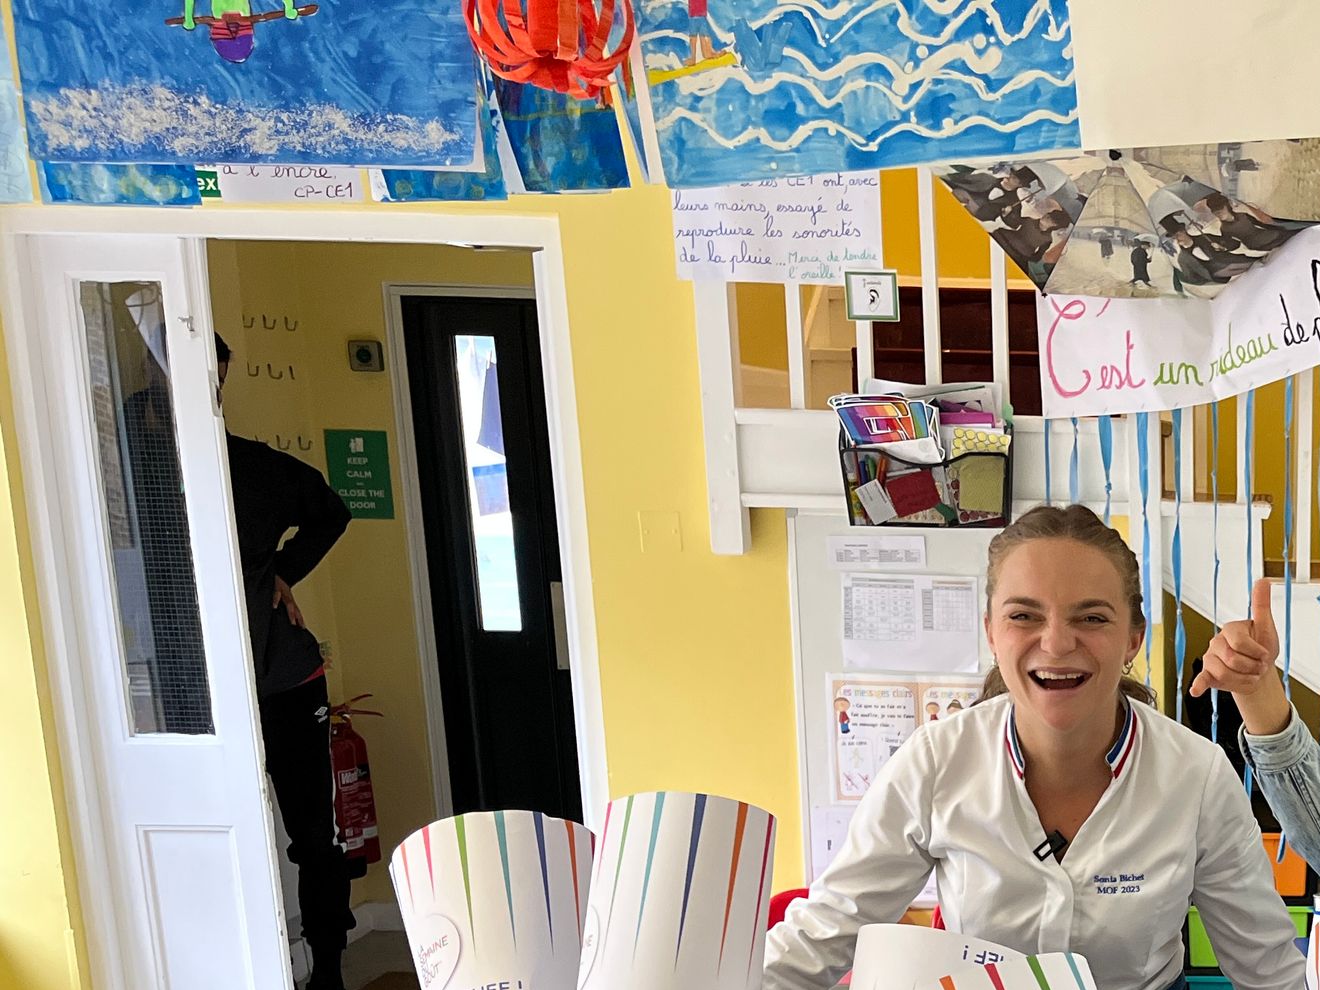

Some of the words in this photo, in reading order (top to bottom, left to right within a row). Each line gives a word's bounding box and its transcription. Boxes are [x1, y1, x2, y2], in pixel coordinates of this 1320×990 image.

[196, 177, 217, 191] ex
[294, 182, 353, 198] CP-CE1
[673, 190, 709, 212] leurs
[777, 197, 827, 225] essayé
[836, 199, 853, 213] de
[676, 221, 754, 248] reproduire
[763, 215, 783, 238] les
[792, 219, 861, 239] sonorités
[680, 246, 700, 263] de
[708, 240, 727, 264] la
[1046, 297, 1146, 398] C'est
[1152, 361, 1204, 387] un
[1209, 322, 1278, 381] rideau
[1280, 293, 1310, 346] de
[347, 457, 369, 465] KEEP
[346, 470, 372, 479] CALM
[338, 489, 367, 497] CLOSE
[368, 489, 385, 498] THE
[350, 501, 376, 509] DOOR
[1097, 886, 1119, 894] MOF
[1121, 885, 1141, 893] 2023
